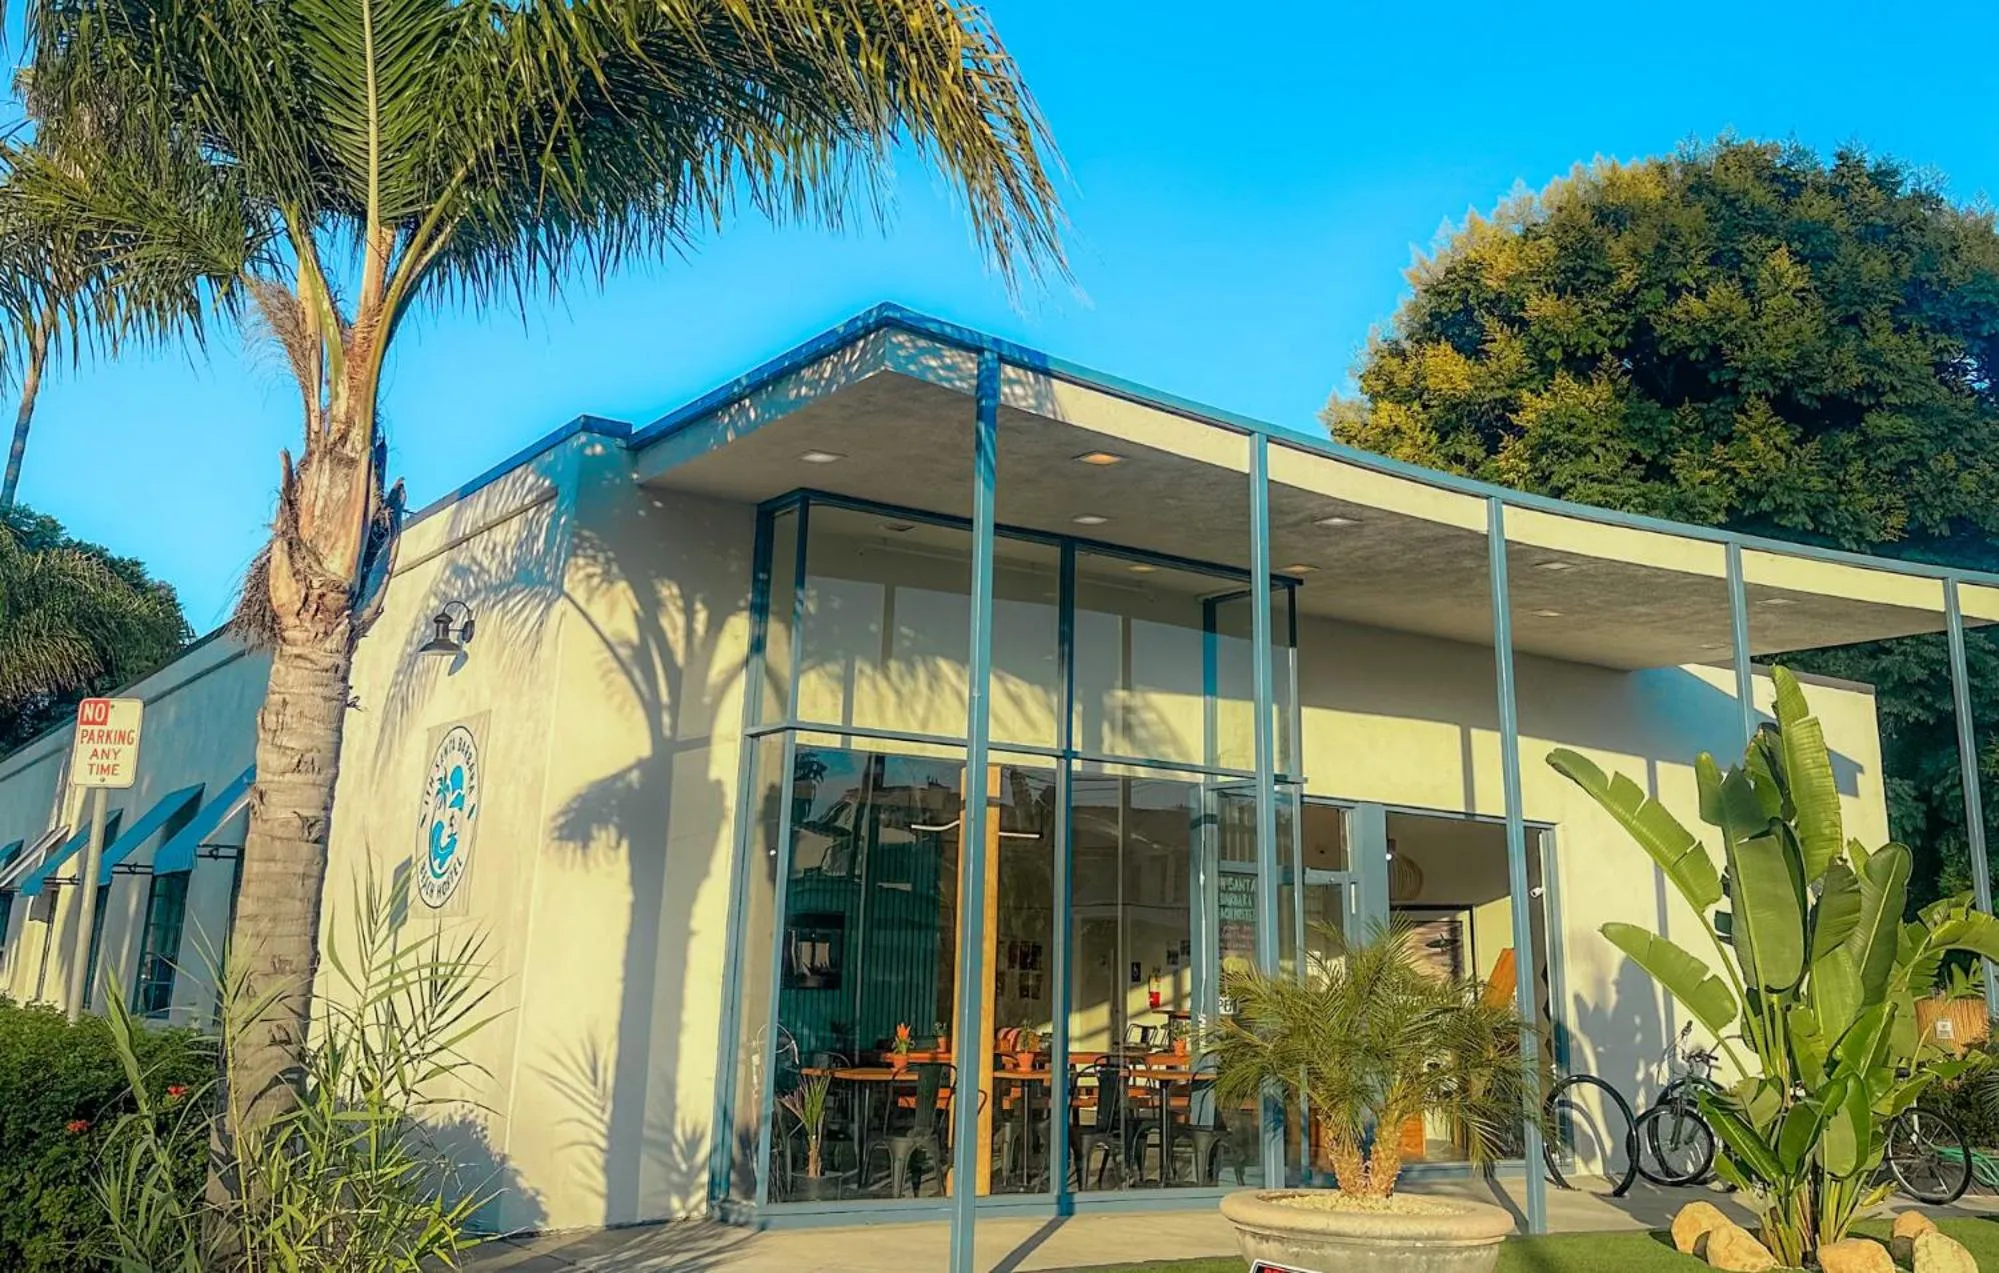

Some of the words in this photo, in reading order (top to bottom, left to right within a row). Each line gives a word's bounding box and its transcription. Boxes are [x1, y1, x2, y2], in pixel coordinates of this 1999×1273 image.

[82, 703, 106, 722] NO
[80, 729, 135, 745] PARKING
[89, 748, 122, 760] ANY
[88, 763, 120, 776] TIME
[436, 856, 462, 898] HOSTEL
